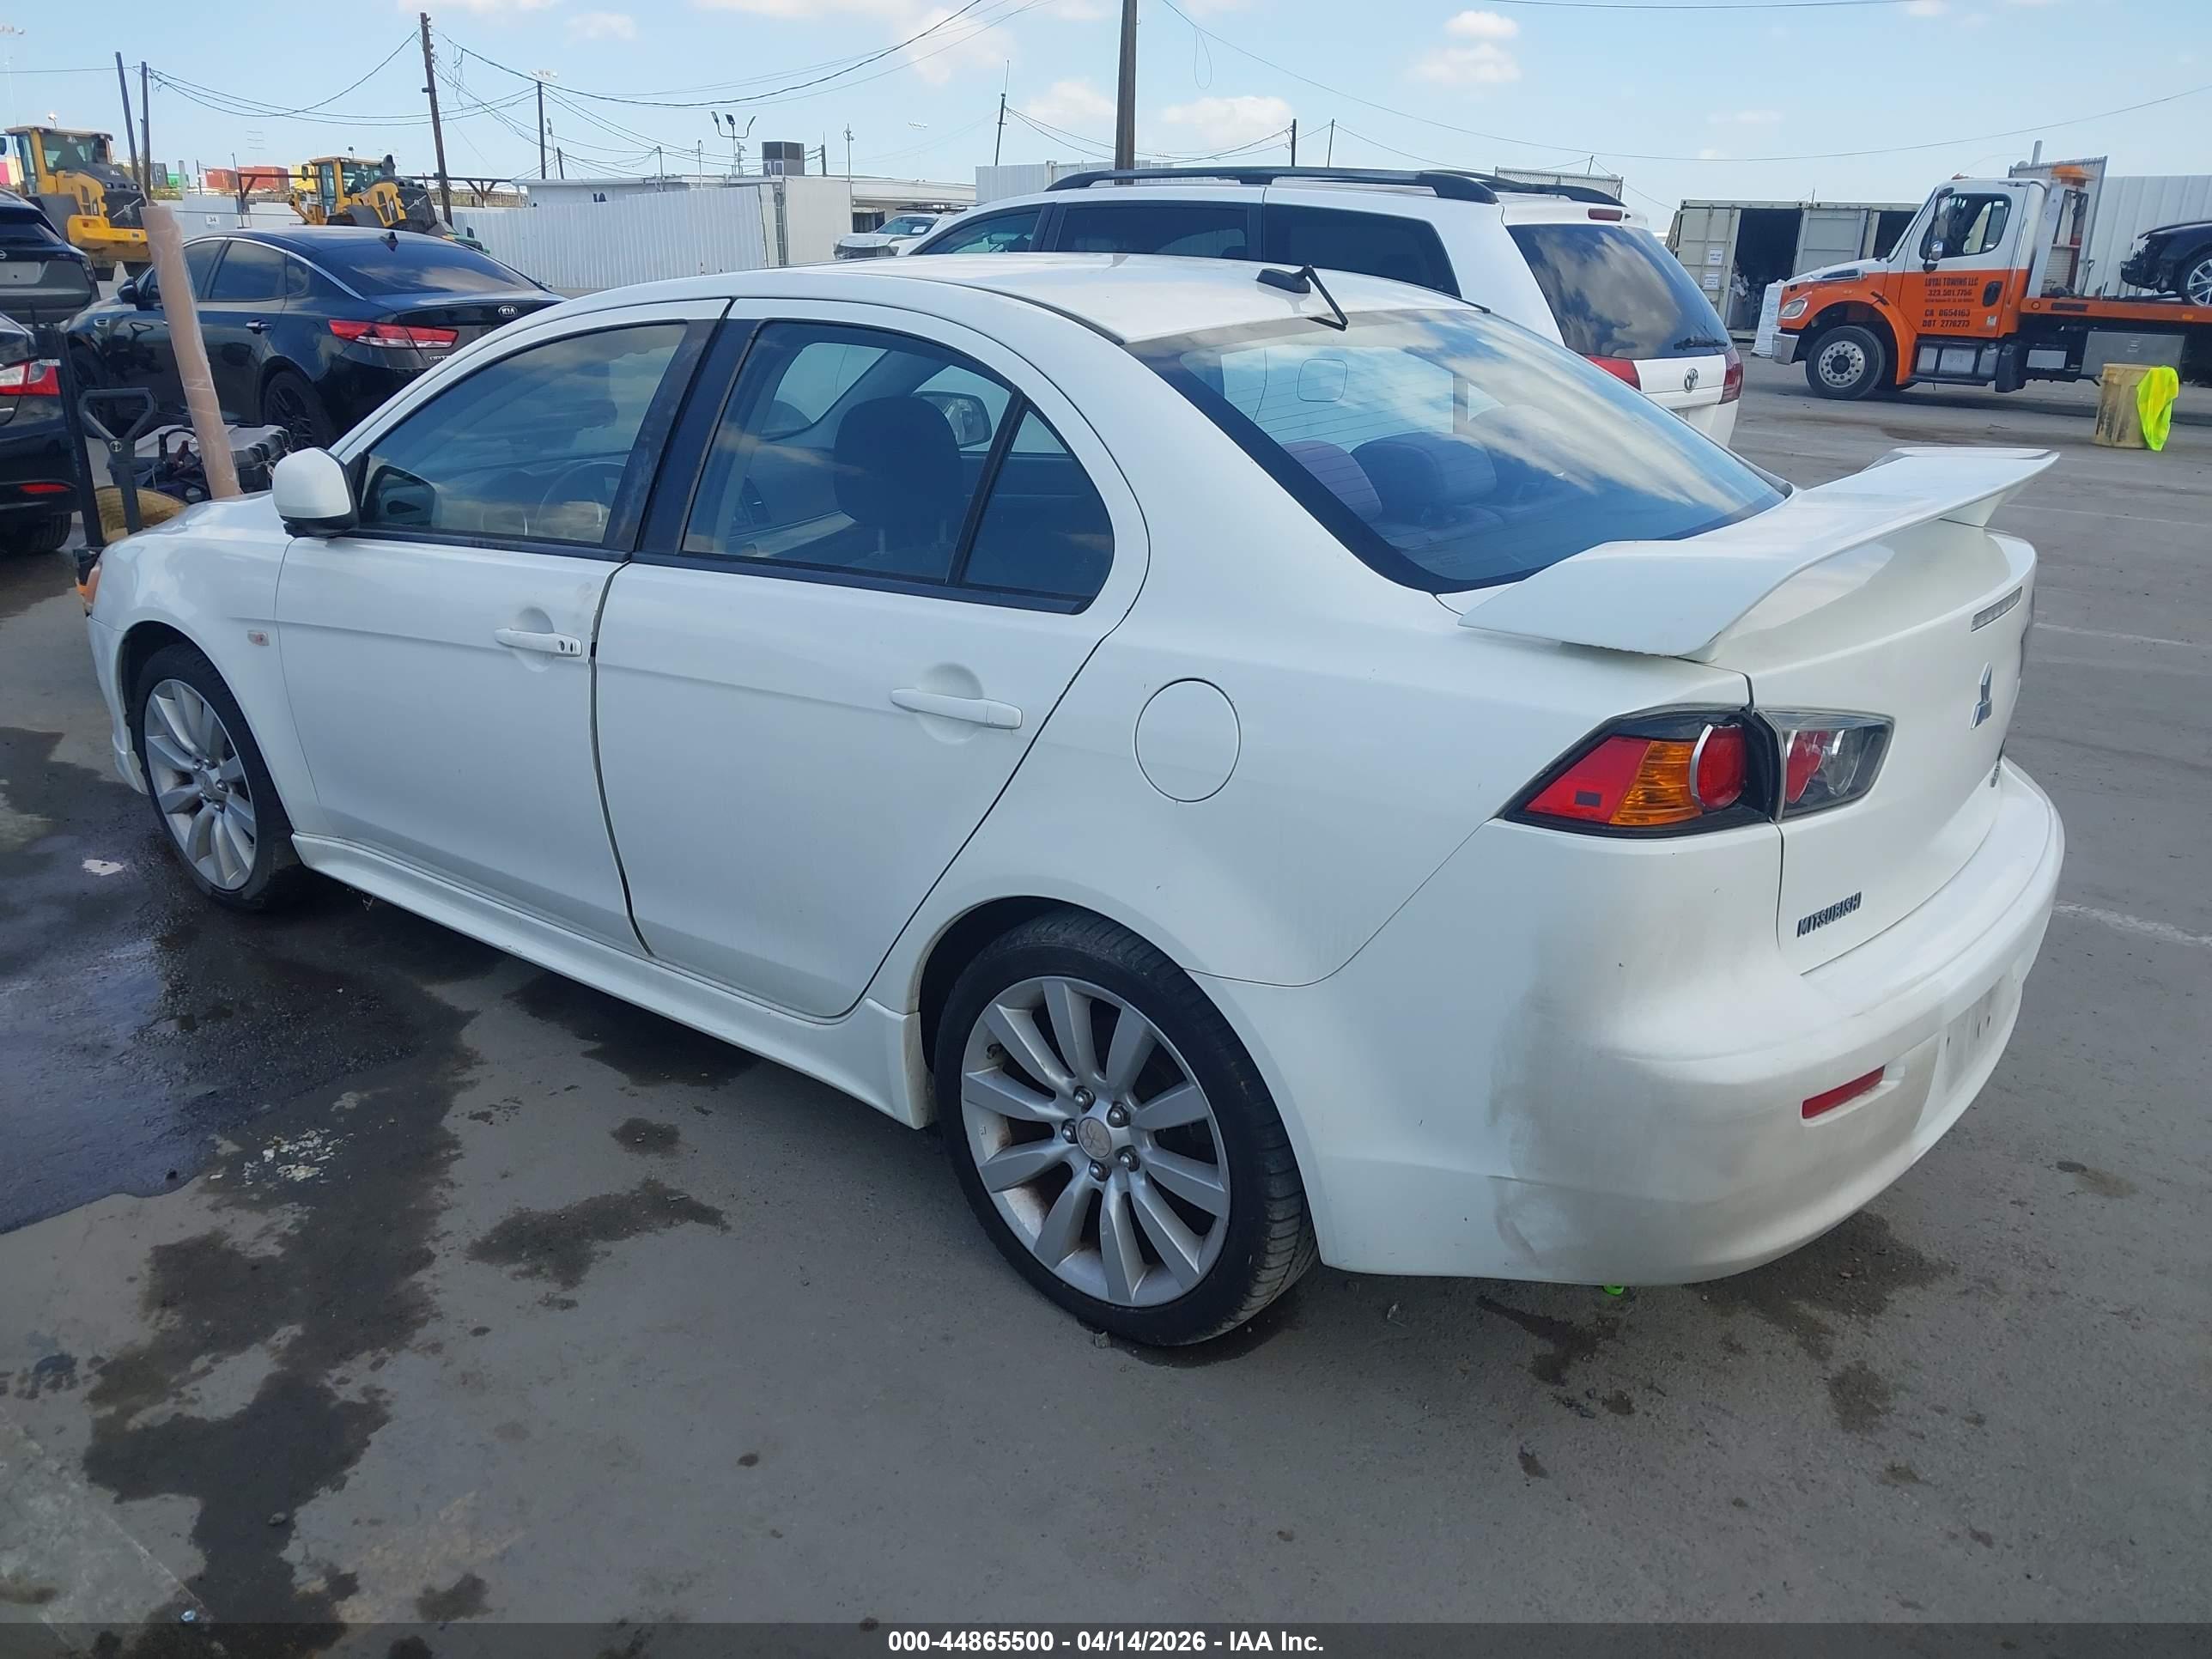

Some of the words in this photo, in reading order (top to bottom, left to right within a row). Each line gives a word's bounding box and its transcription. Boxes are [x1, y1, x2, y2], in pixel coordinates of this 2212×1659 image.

[1943, 277, 1967, 286] TOWING
[1968, 276, 1978, 286] LLC
[501, 307, 515, 316] KIA
[1796, 891, 1862, 938] MITSUBISHI
